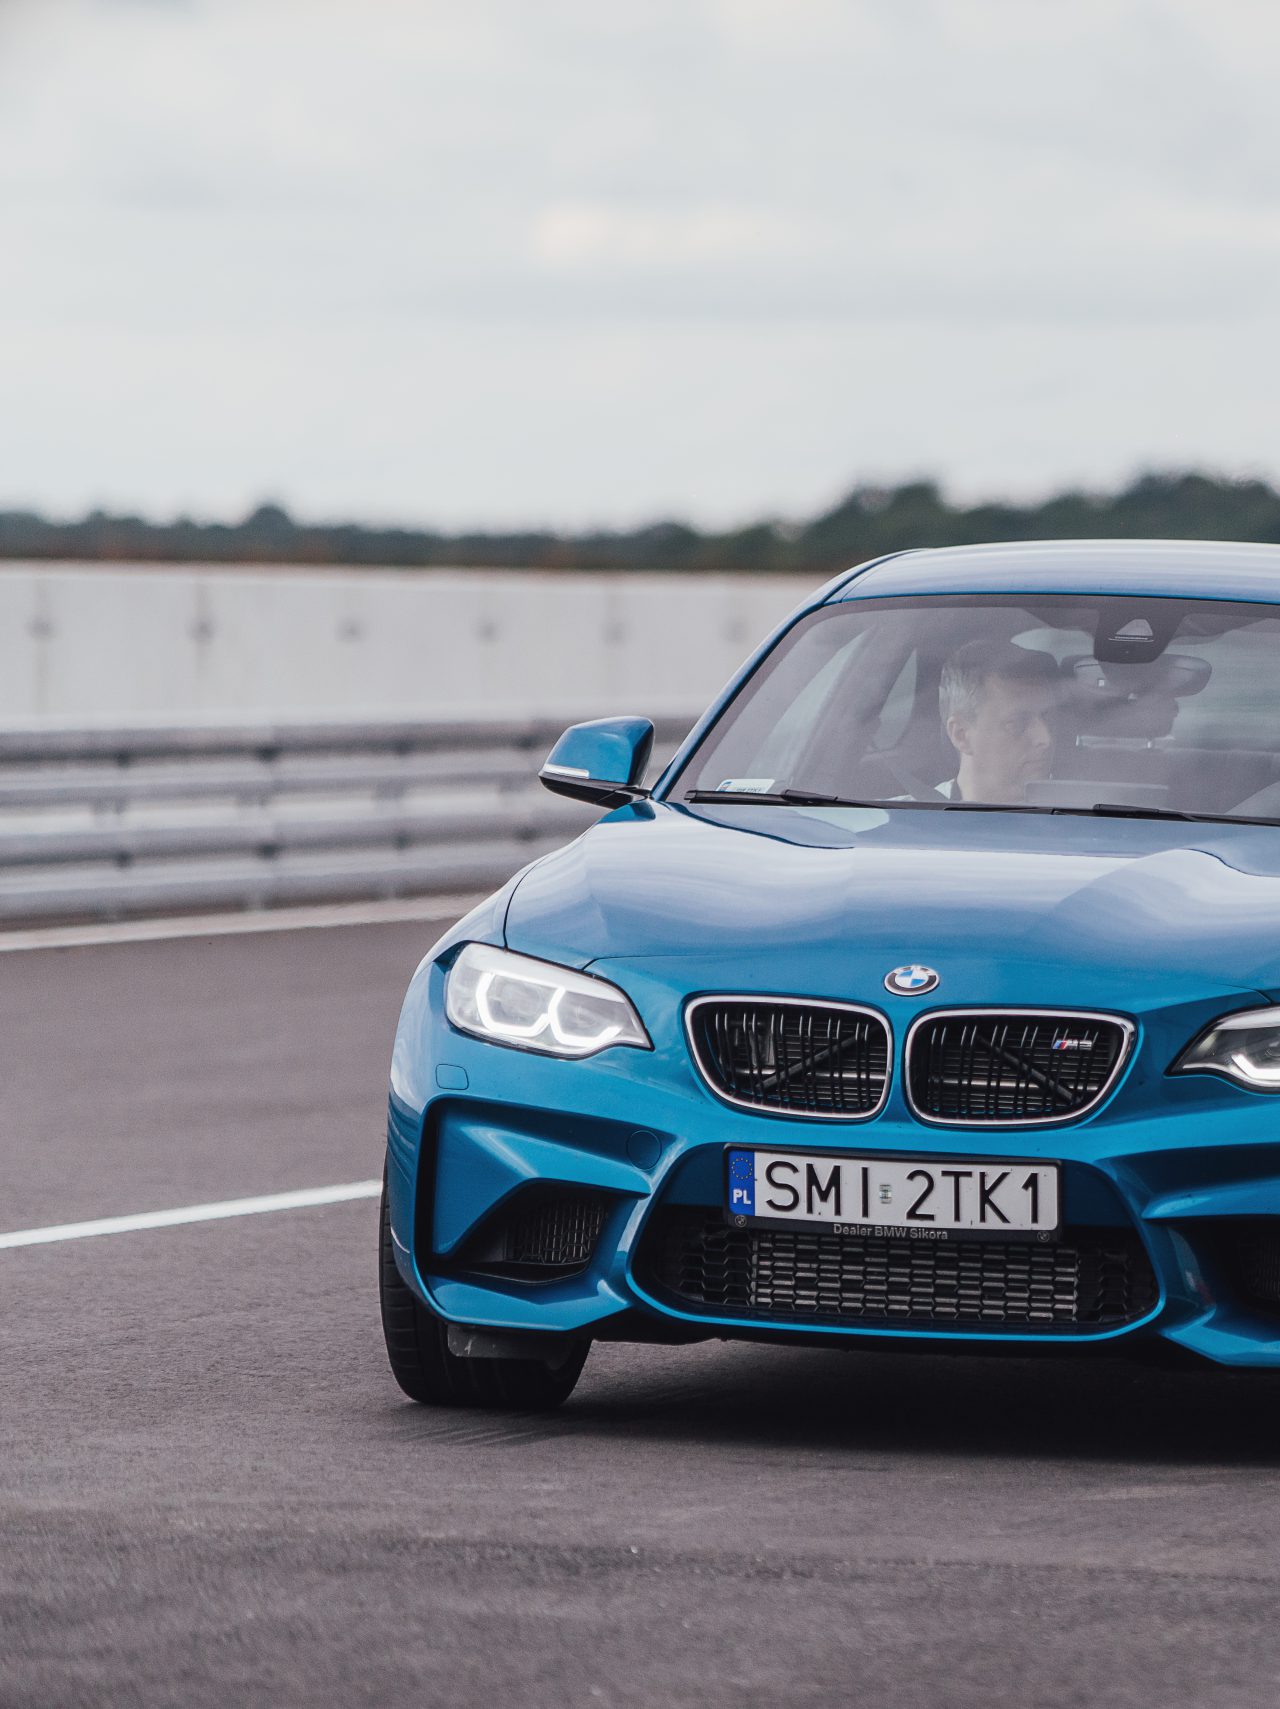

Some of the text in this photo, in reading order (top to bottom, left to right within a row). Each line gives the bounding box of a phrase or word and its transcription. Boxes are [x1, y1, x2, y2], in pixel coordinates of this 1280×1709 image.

[733, 1188, 751, 1205] PL
[765, 1160, 1039, 1224] SMI 2TK1
[833, 1223, 949, 1240] Dealer BMW Sikora
